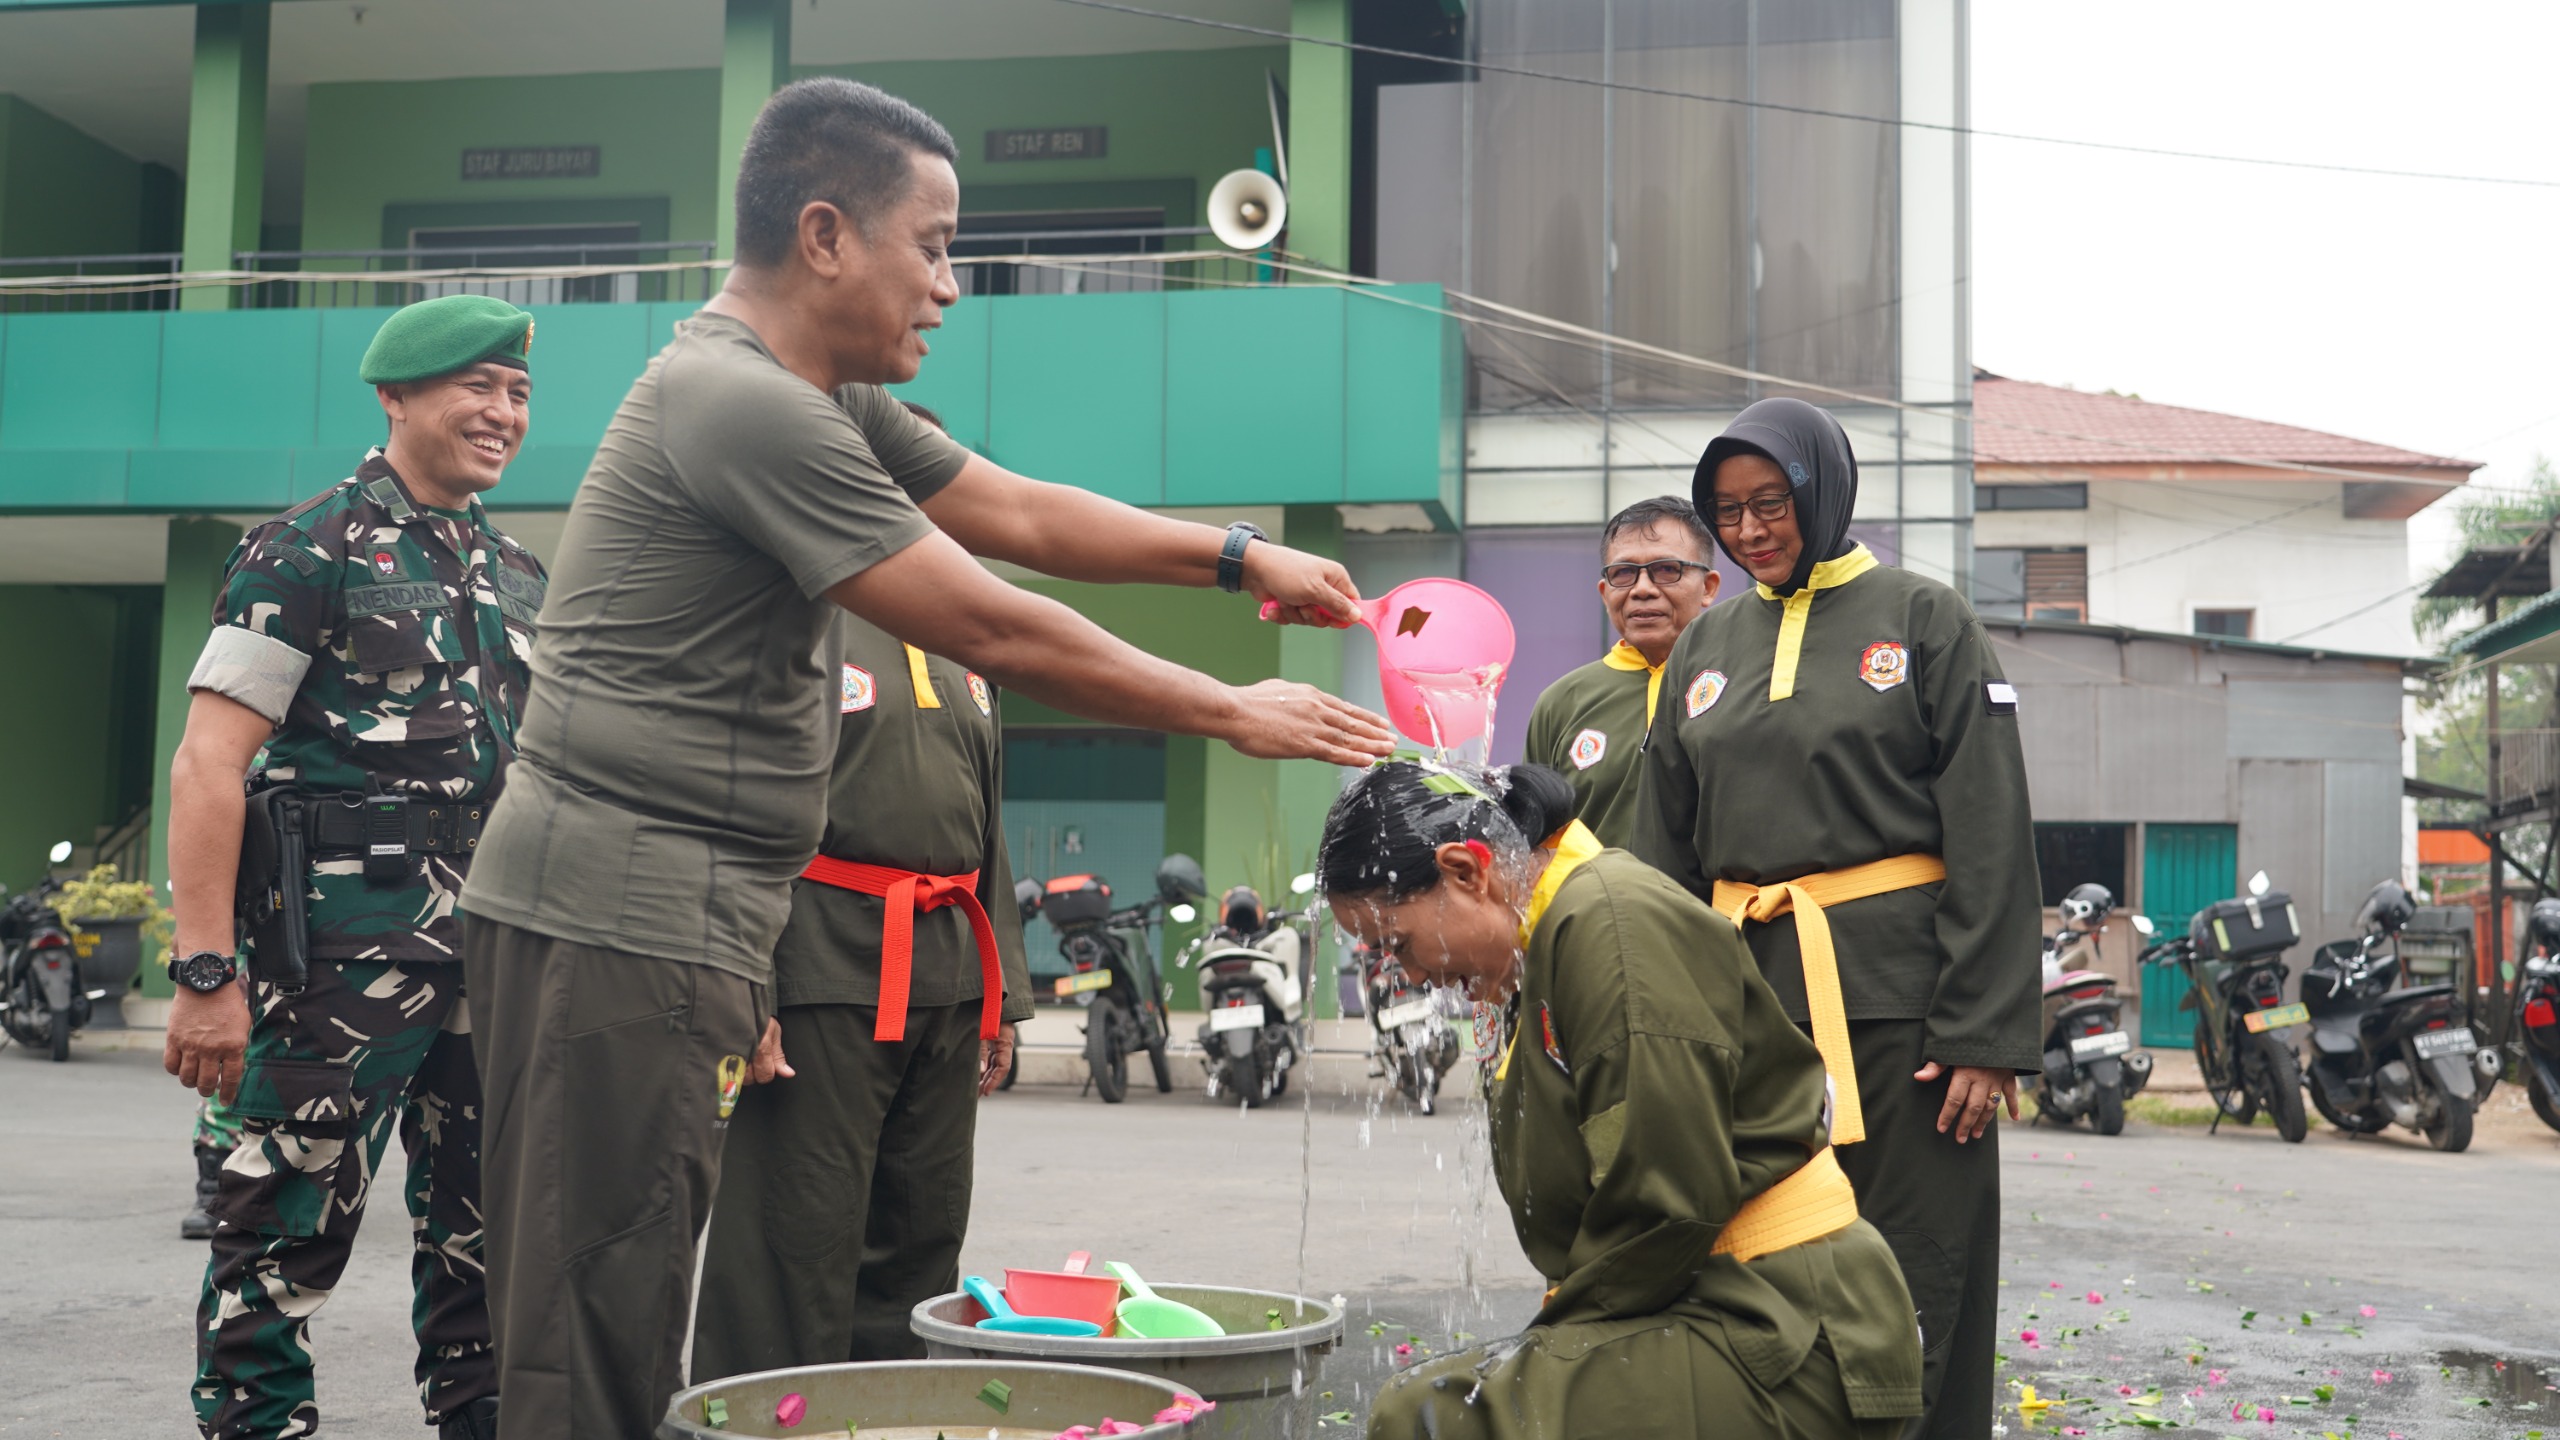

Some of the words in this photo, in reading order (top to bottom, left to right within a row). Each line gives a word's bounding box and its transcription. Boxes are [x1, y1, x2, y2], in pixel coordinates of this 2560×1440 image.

[1005, 133, 1045, 155] STAF
[1051, 132, 1084, 152] REN
[465, 153, 501, 174] STAF
[503, 152, 544, 173] JURU
[545, 150, 593, 172] BAYAR
[352, 585, 442, 612] NENDAR
